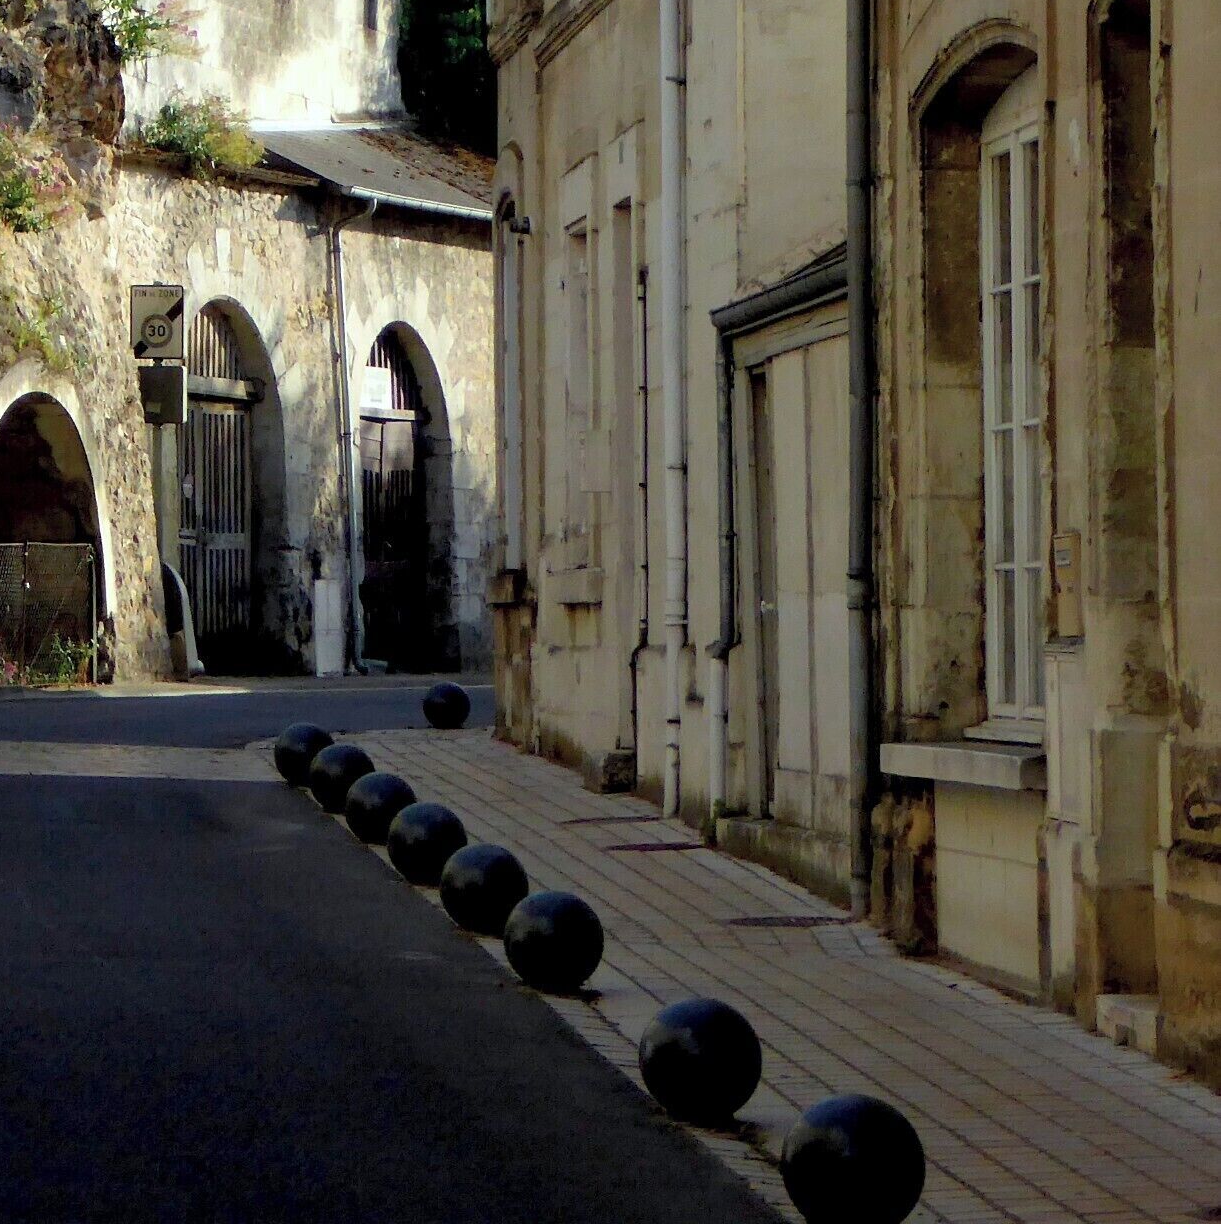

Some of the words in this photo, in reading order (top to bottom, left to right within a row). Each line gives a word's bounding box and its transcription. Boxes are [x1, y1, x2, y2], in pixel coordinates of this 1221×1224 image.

[134, 289, 147, 297] FIN
[158, 289, 180, 298] ZONE
[148, 325, 166, 337] 30
